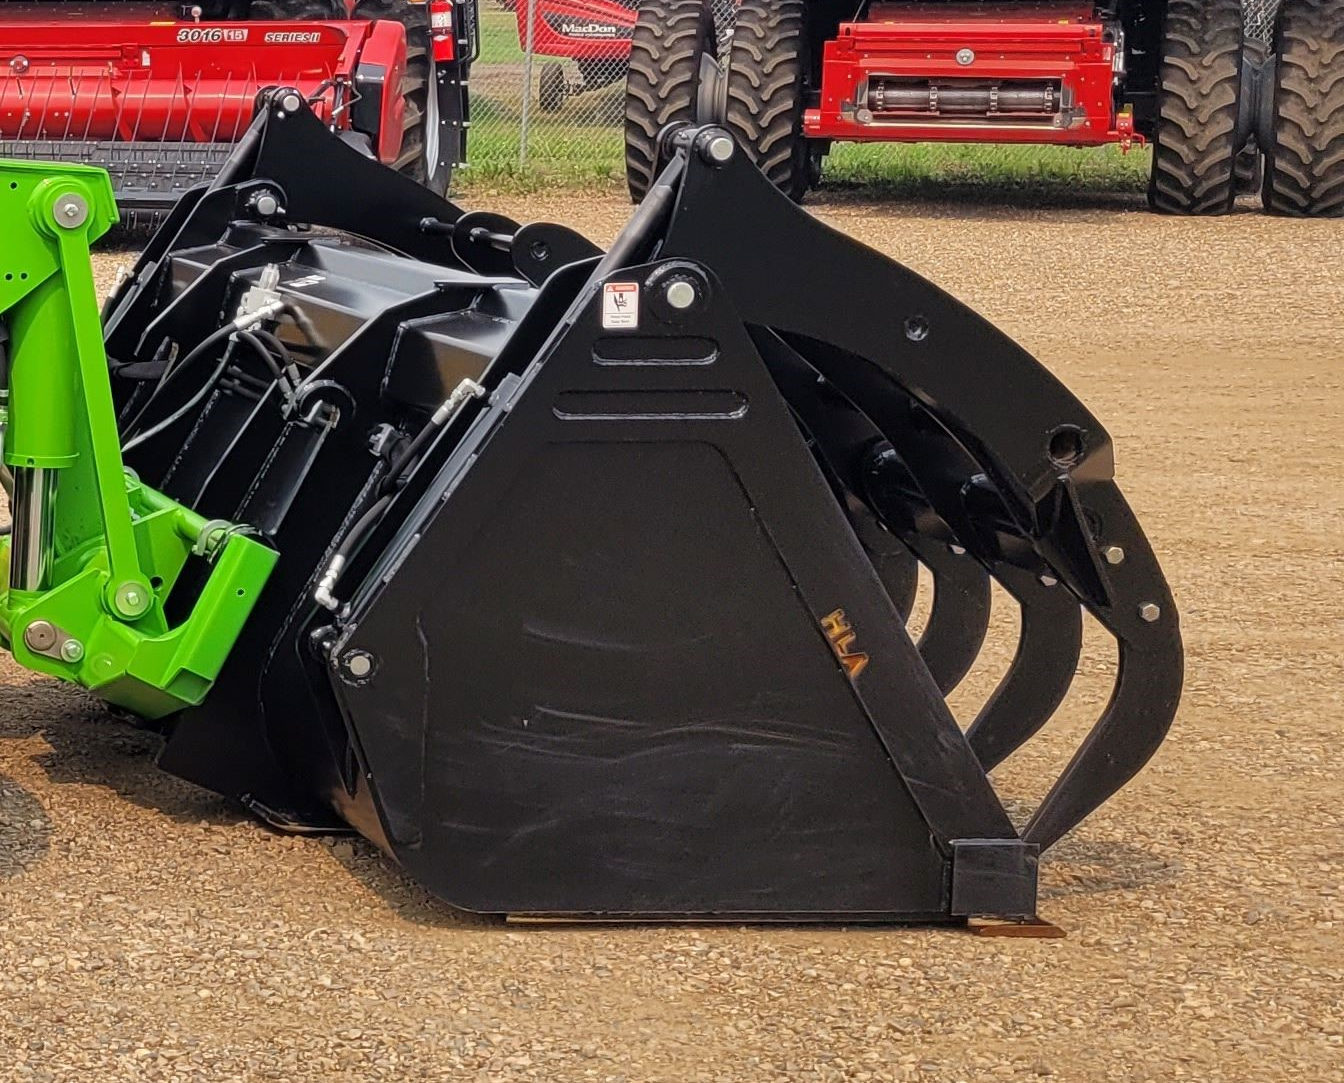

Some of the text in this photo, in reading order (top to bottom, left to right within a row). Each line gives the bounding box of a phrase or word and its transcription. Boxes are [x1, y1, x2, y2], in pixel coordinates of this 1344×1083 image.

[177, 28, 223, 42] 3016
[227, 29, 245, 42] 15
[562, 23, 617, 33] MacDon
[820, 607, 870, 678] HLA
